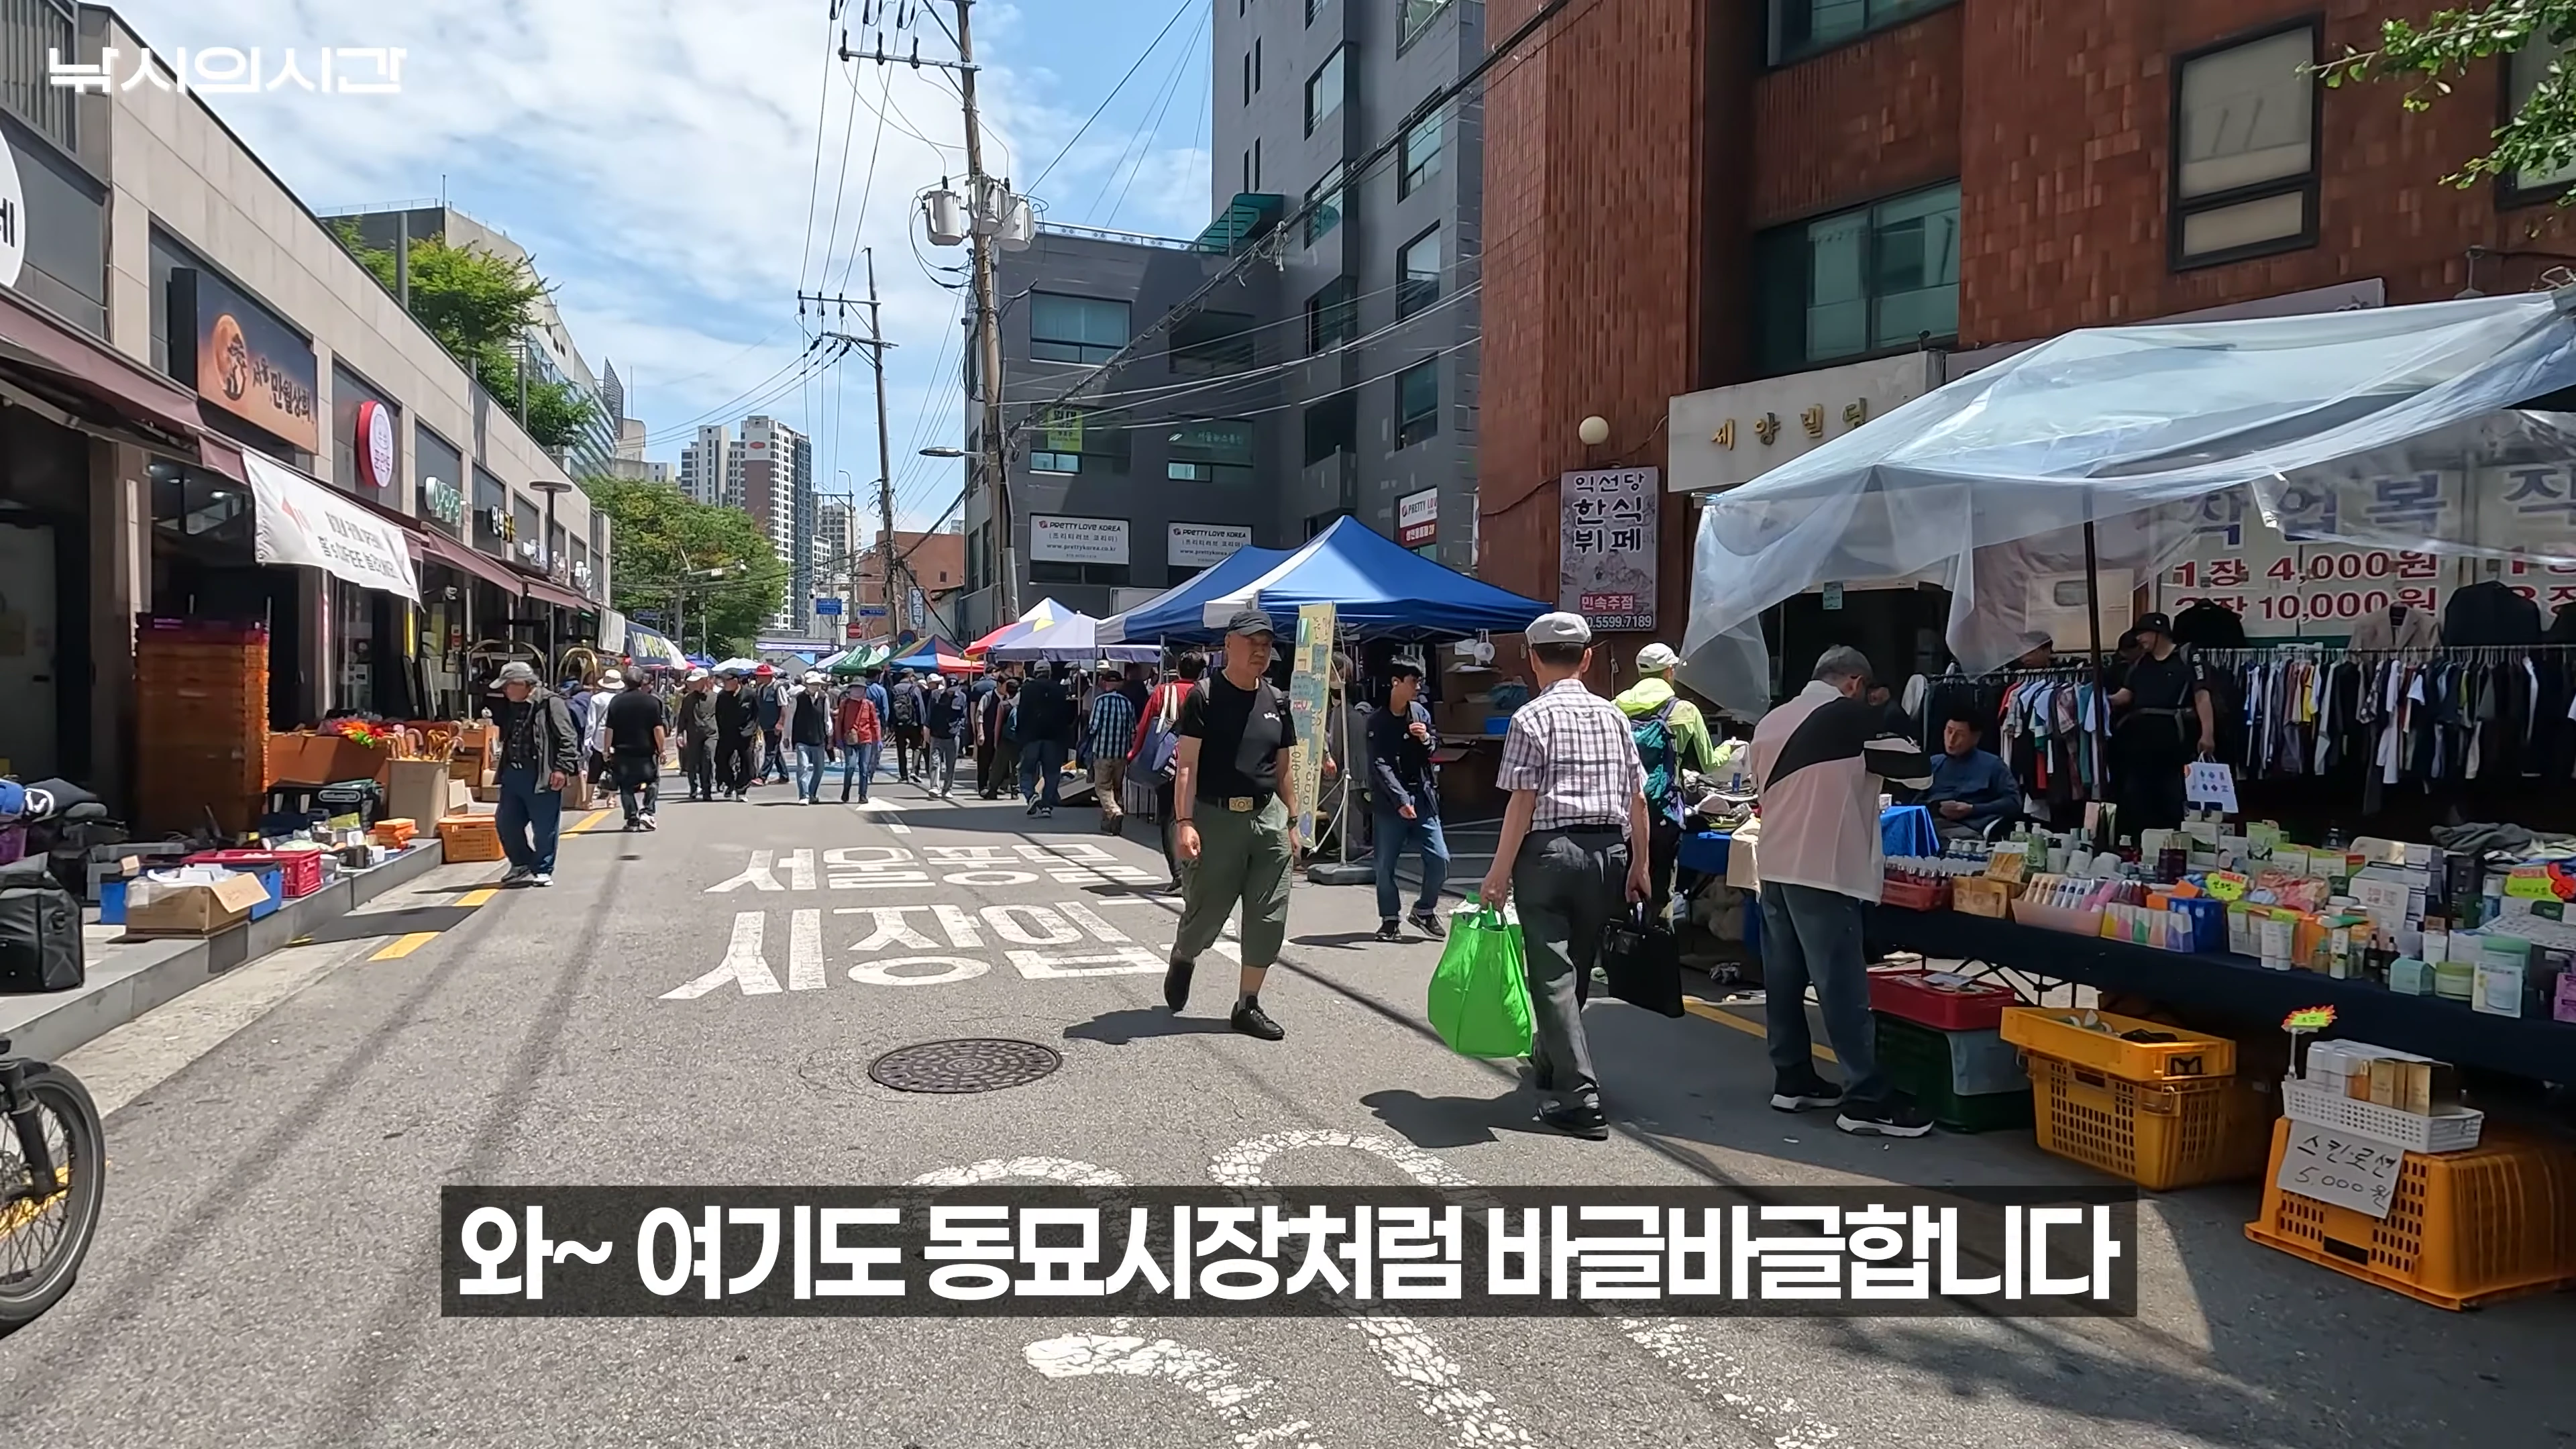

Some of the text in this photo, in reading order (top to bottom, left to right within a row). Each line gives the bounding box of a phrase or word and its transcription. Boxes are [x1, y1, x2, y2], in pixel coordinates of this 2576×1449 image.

[1711, 396, 1868, 451] 세양빌딩
[1575, 473, 1646, 493] 익선당
[1572, 496, 1643, 526] 한식
[1574, 527, 1642, 553] 뷔페
[2267, 550, 2437, 585] 4,000원
[1580, 594, 1634, 611] 민속주점
[1587, 614, 1653, 629] 0.5599.7189
[704, 843, 1162, 893] 서울풍물
